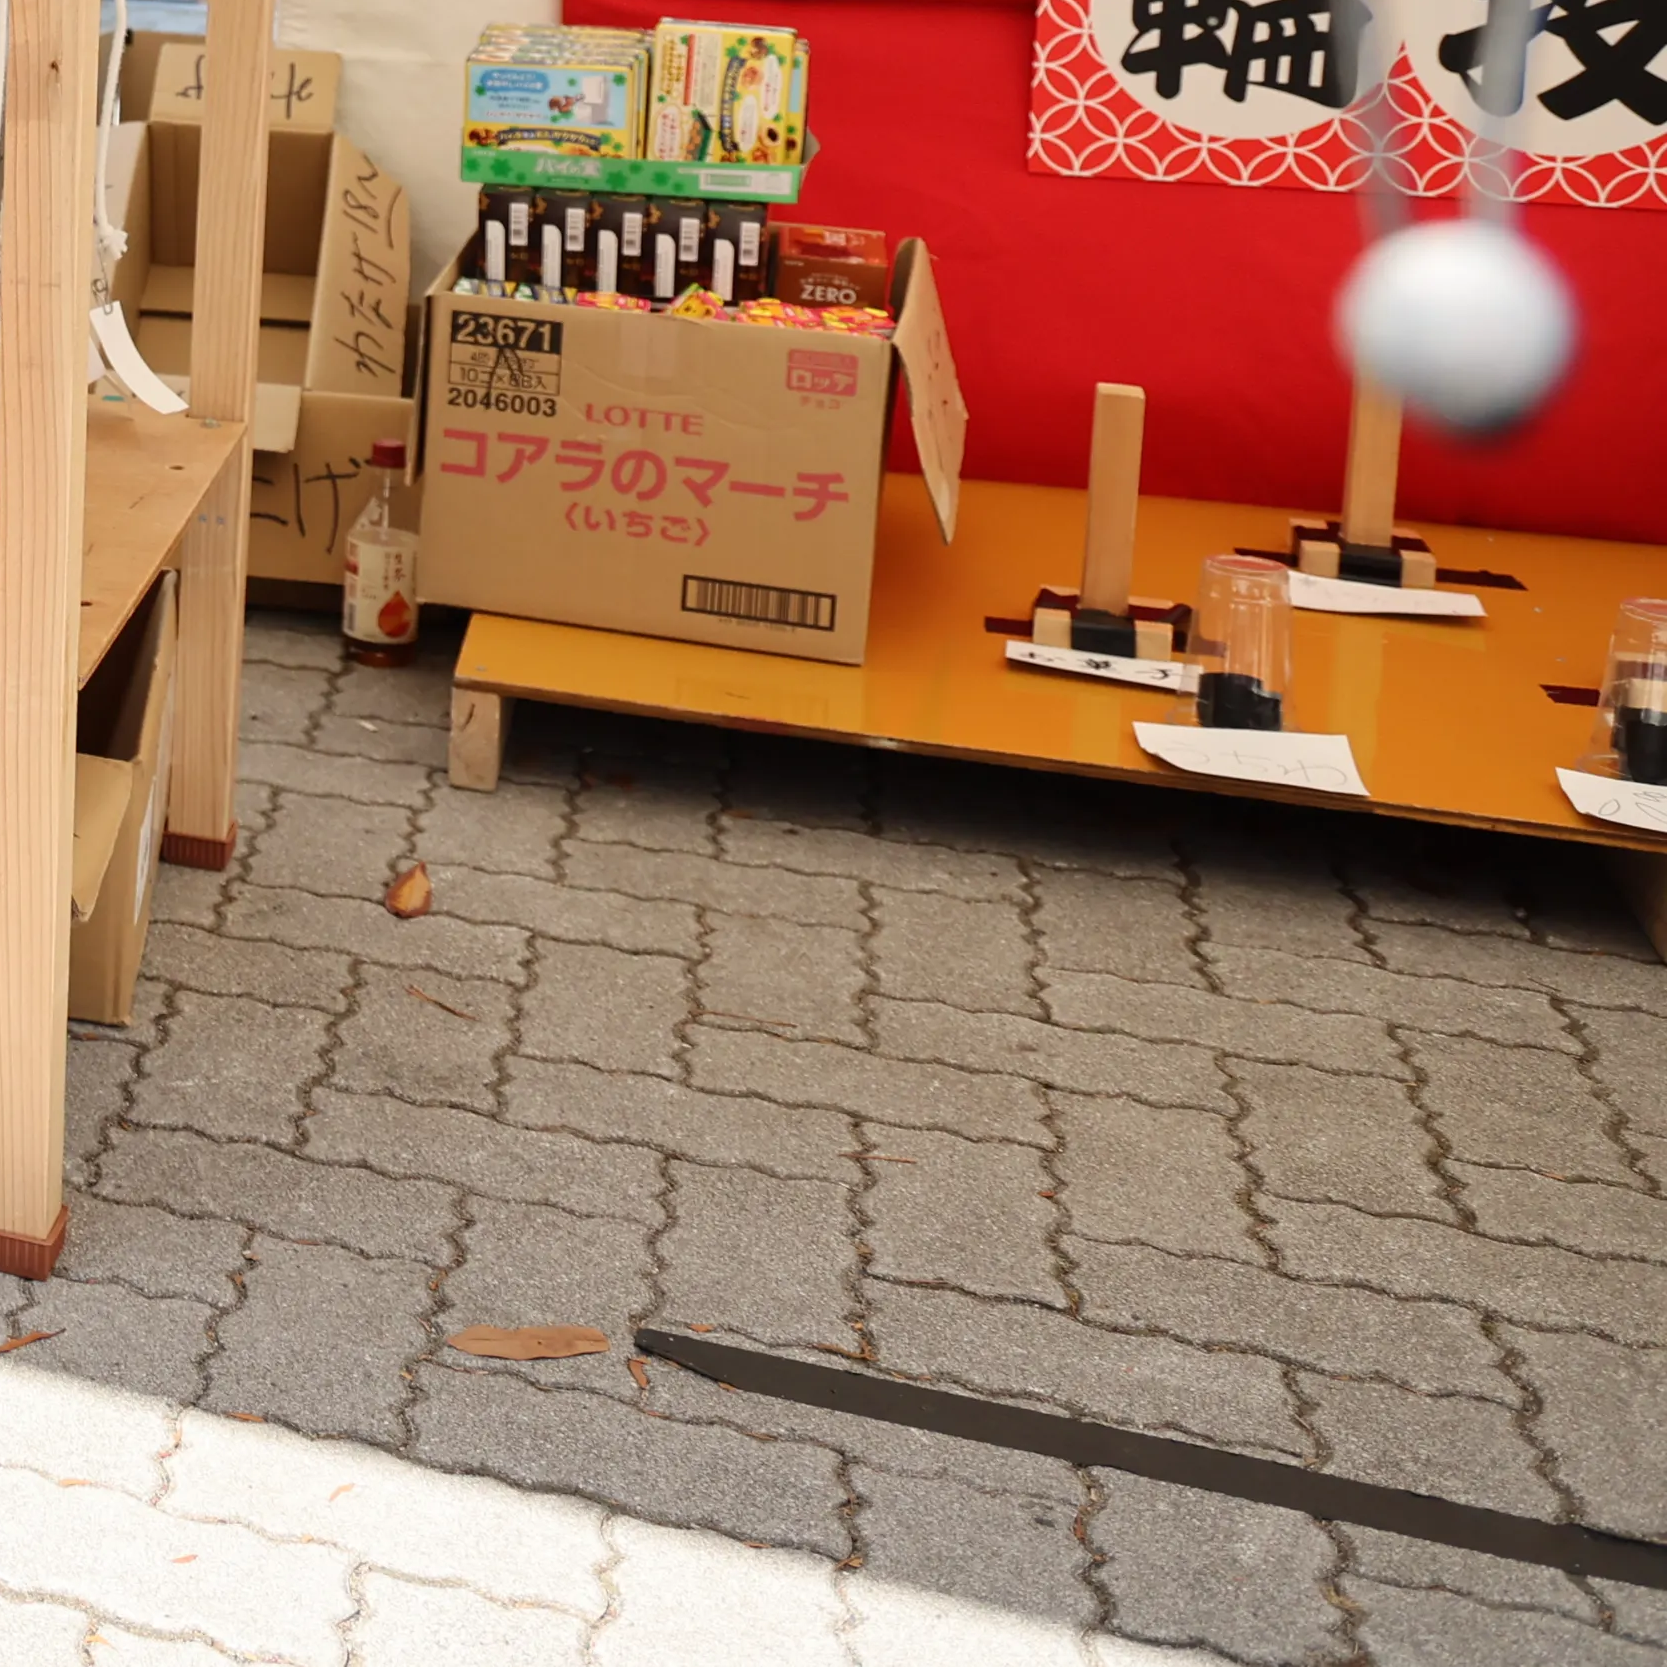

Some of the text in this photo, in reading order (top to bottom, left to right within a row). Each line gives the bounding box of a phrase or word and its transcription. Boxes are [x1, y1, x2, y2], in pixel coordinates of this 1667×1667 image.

[800, 284, 857, 304] ZERO
[457, 315, 552, 352] 23671
[792, 369, 854, 392] ロッテ
[448, 387, 557, 418] 2046003
[585, 403, 704, 435] LOTTE
[440, 428, 849, 521] コアラのマーチ
